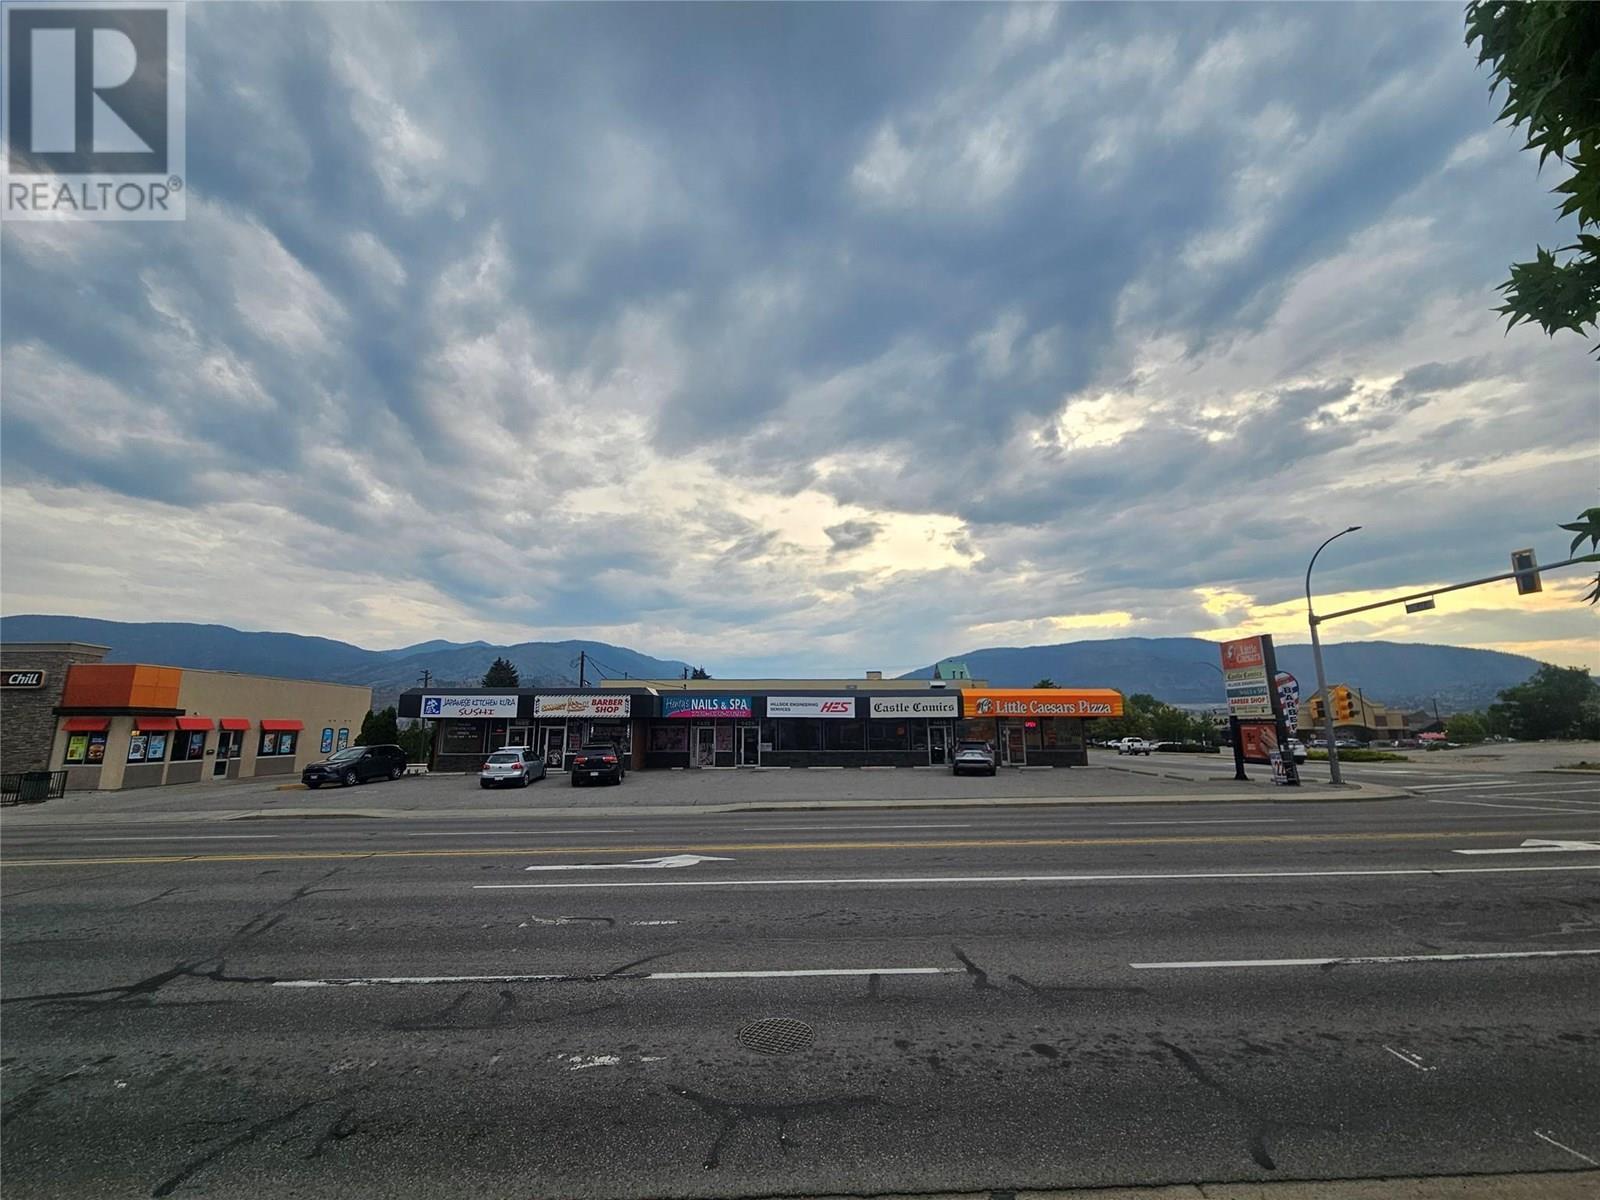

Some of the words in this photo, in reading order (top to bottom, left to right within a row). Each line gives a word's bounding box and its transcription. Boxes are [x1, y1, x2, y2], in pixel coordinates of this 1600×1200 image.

[8, 673, 39, 684] Chill
[442, 697, 471, 707] JAPANESE
[472, 698, 498, 706] KITCHEN
[499, 698, 516, 706] KURA
[691, 699, 718, 710] NAILS
[720, 702, 727, 710] &
[729, 698, 748, 710] SPA
[820, 702, 852, 713] HES
[874, 702, 910, 713] Castle
[912, 702, 955, 712] Comics
[995, 700, 1027, 713] Little
[1029, 700, 1076, 714] Caesars
[1078, 700, 1112, 714] Pizza
[458, 707, 496, 716] SUSHI
[1213, 718, 1229, 726] SAF
